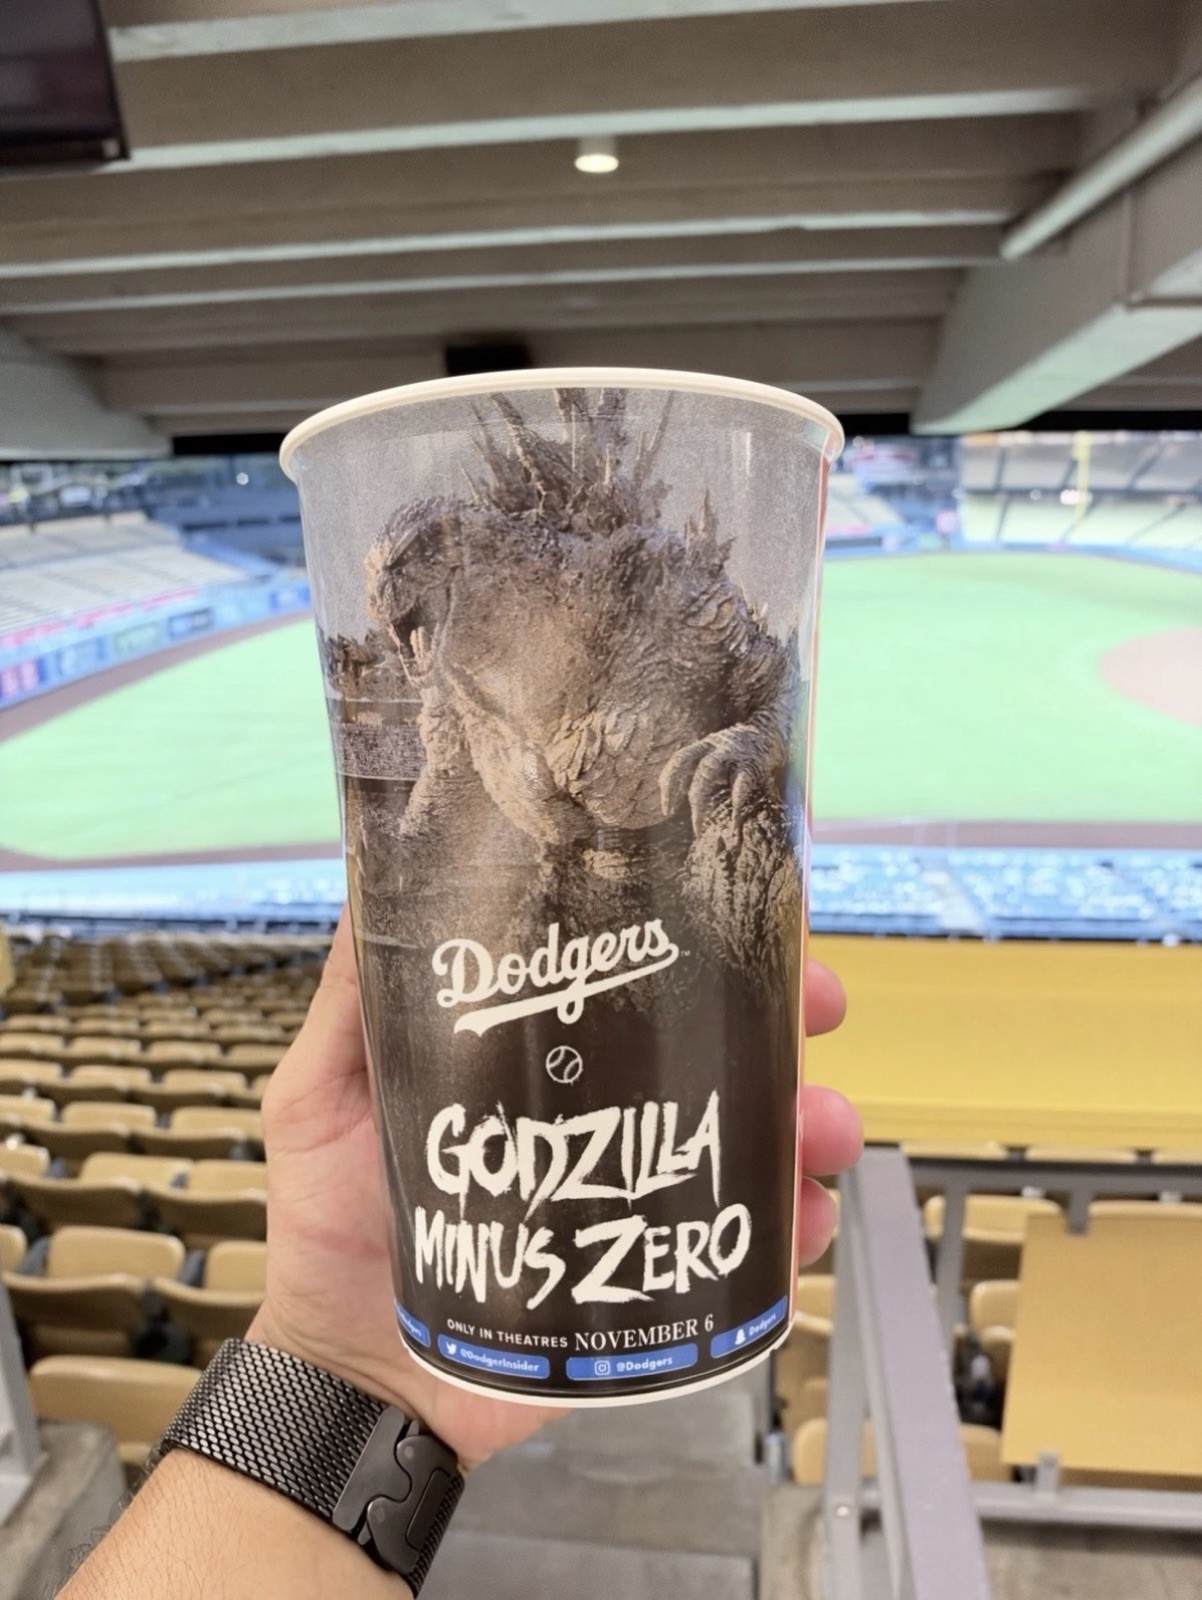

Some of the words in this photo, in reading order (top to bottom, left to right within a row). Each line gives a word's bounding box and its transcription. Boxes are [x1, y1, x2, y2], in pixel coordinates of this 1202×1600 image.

[432, 919, 679, 1036] Dodgers
[425, 1088, 720, 1220] GODZILLA
[414, 1204, 567, 1310] MINUS
[570, 1202, 753, 1304] ZERO
[447, 1318, 475, 1336] ONLY
[479, 1327, 493, 1340] IN
[497, 1331, 568, 1348] THEATRES
[575, 1318, 699, 1351] NOVEMBER
[704, 1313, 714, 1333] 6
[748, 1313, 777, 1337] Dodgers
[459, 1347, 540, 1372] @DodgerInsider
[616, 1356, 674, 1373] @Dodgers
